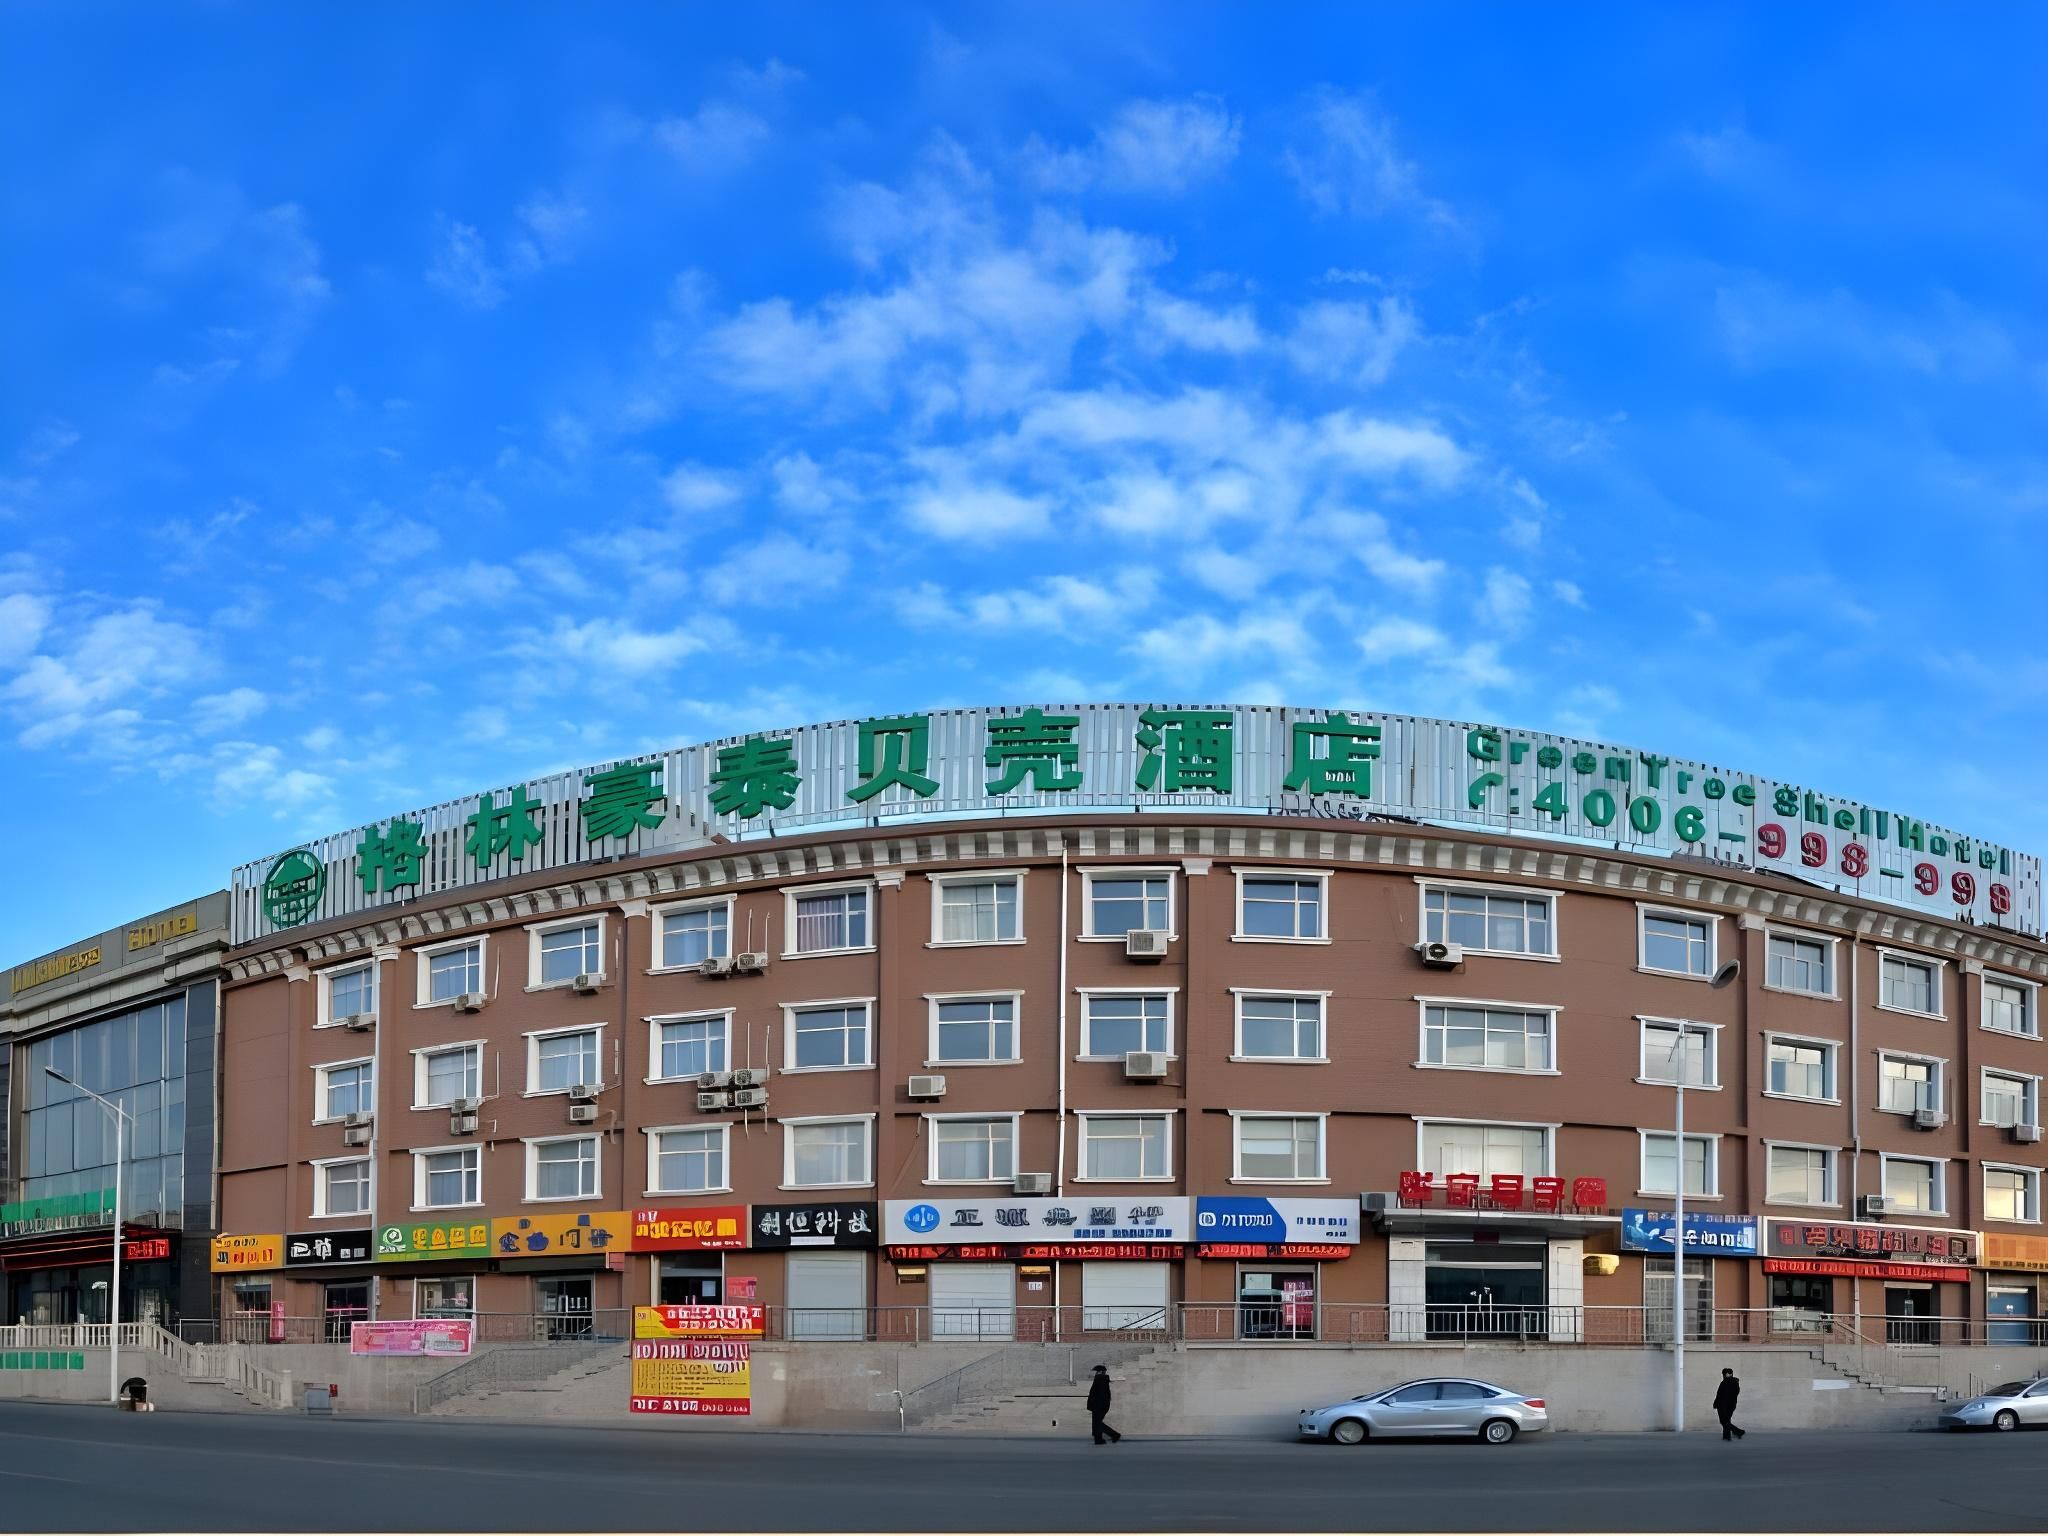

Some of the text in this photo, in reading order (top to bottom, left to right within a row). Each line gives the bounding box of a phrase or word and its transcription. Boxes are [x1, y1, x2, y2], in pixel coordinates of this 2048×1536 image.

[356, 705, 1382, 893] 格林豪泰贝壳酒店
